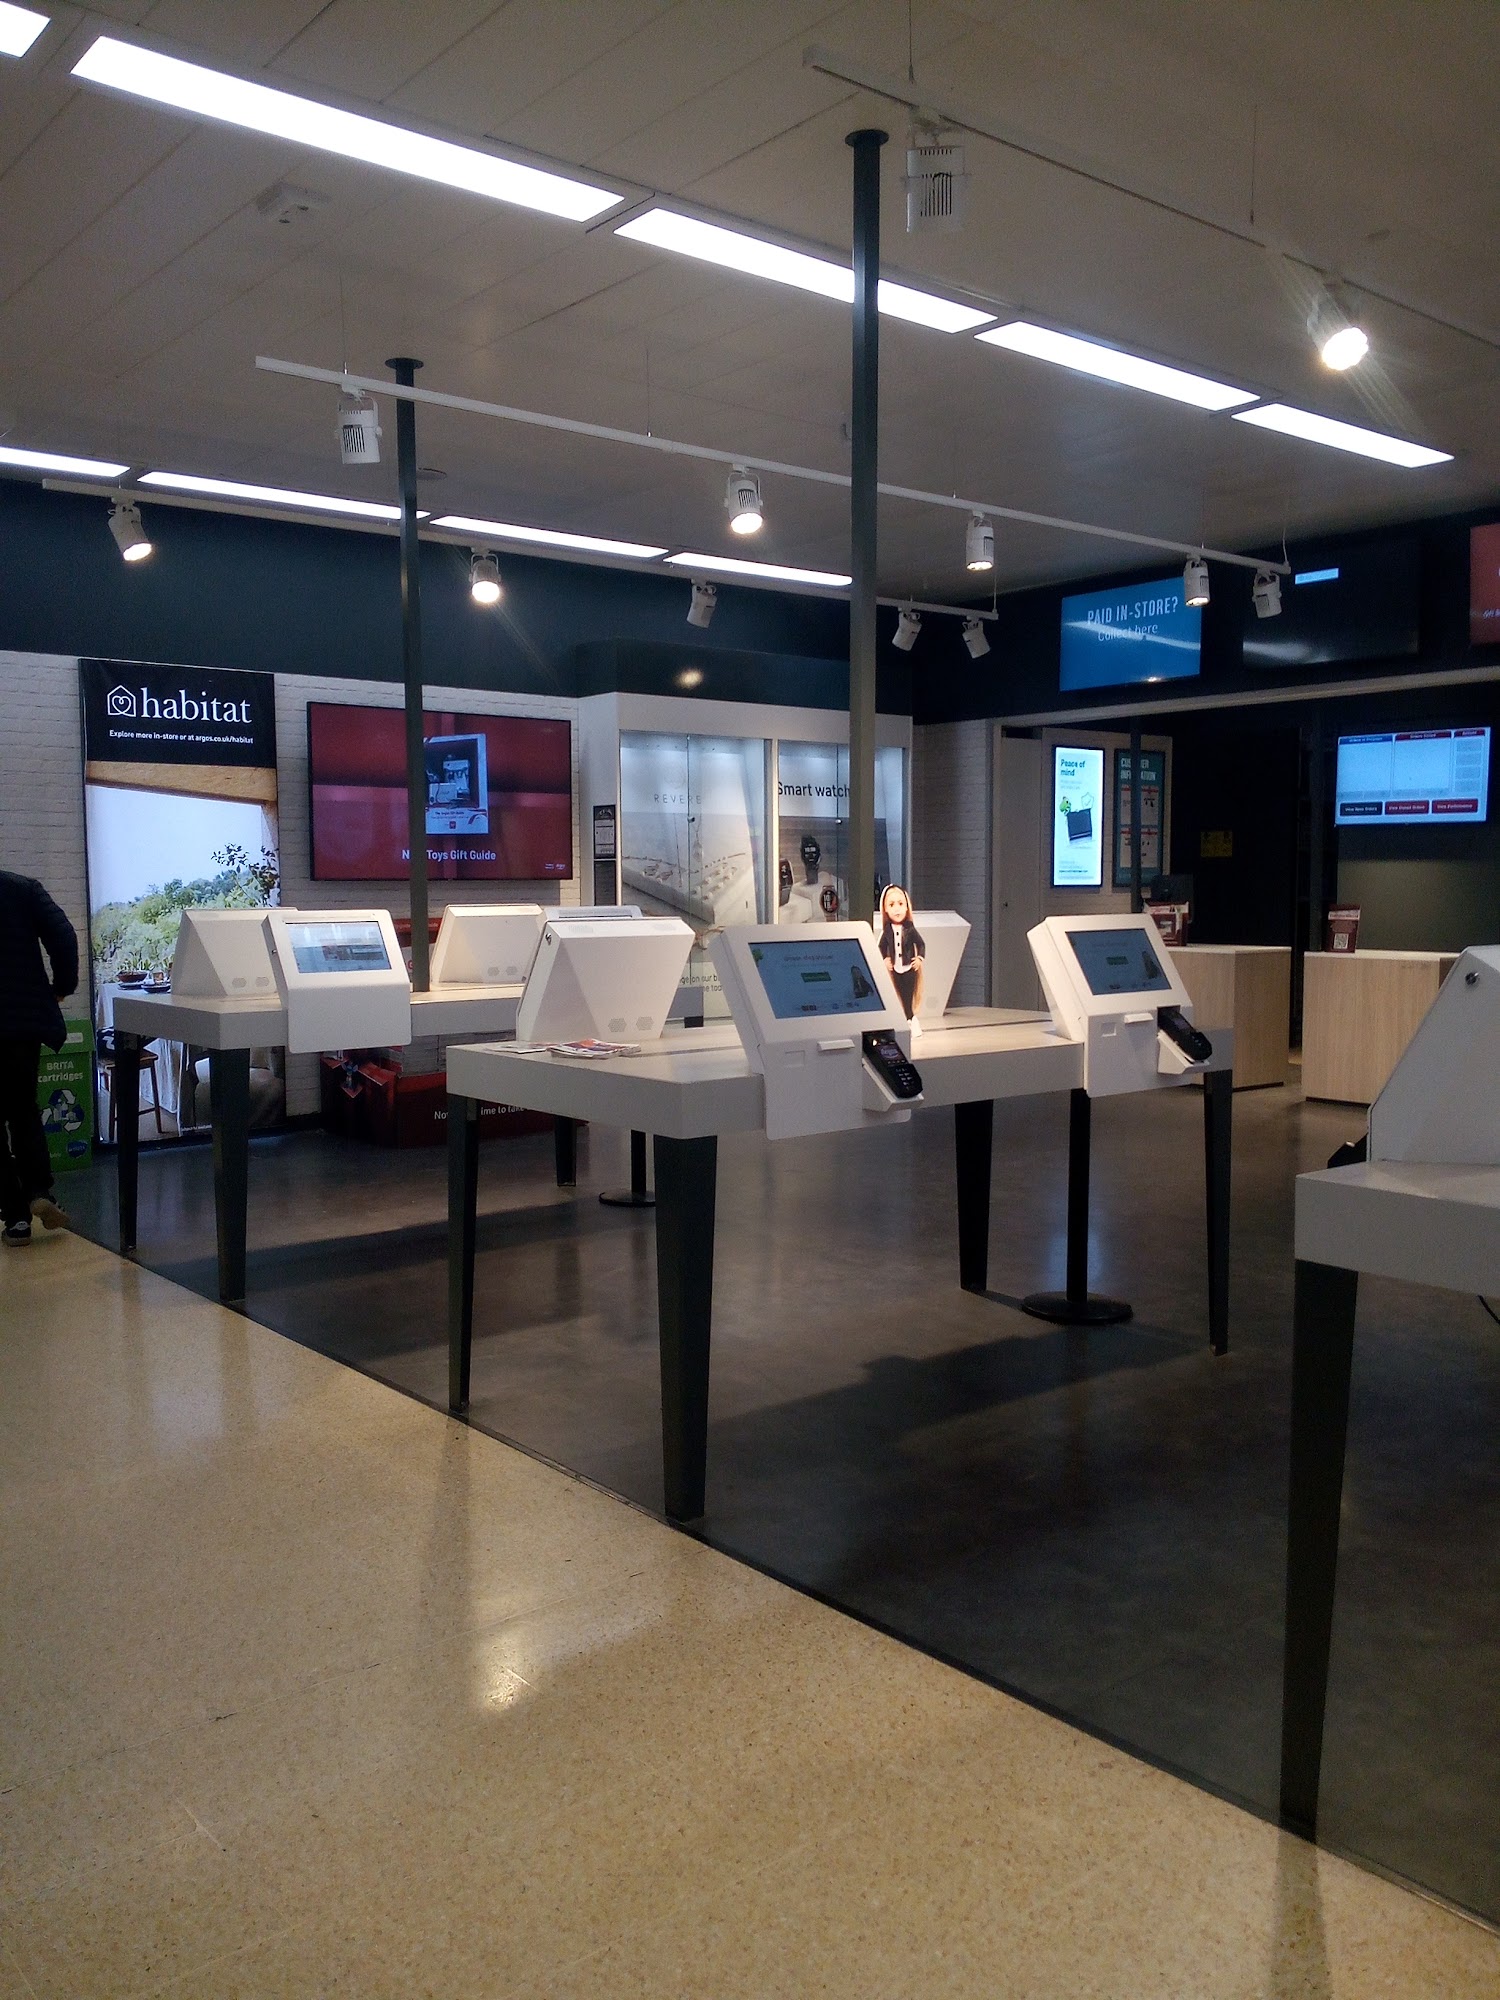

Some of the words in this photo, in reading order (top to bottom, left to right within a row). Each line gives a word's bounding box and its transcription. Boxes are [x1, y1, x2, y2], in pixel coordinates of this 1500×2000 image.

[1087, 607, 1112, 625] PAID
[1116, 596, 1178, 622] IN-STORE?
[1098, 626, 1132, 641] Collect
[1135, 624, 1158, 636] here
[140, 687, 252, 723] habitat
[109, 729, 135, 739] Explore
[153, 732, 178, 741] in-store
[195, 735, 254, 744] argos.co.uk/habitat
[1060, 759, 1078, 767] Peace
[1079, 760, 1086, 768] of
[778, 781, 812, 797] Smart
[653, 793, 702, 805] REVERE
[426, 849, 448, 862] Toys
[450, 849, 467, 860] Gift
[469, 850, 496, 861] Guide
[46, 1060, 74, 1071] BRITA
[38, 1072, 83, 1083] cartridges
[481, 1106, 496, 1116] ime
[498, 1106, 506, 1114] to
